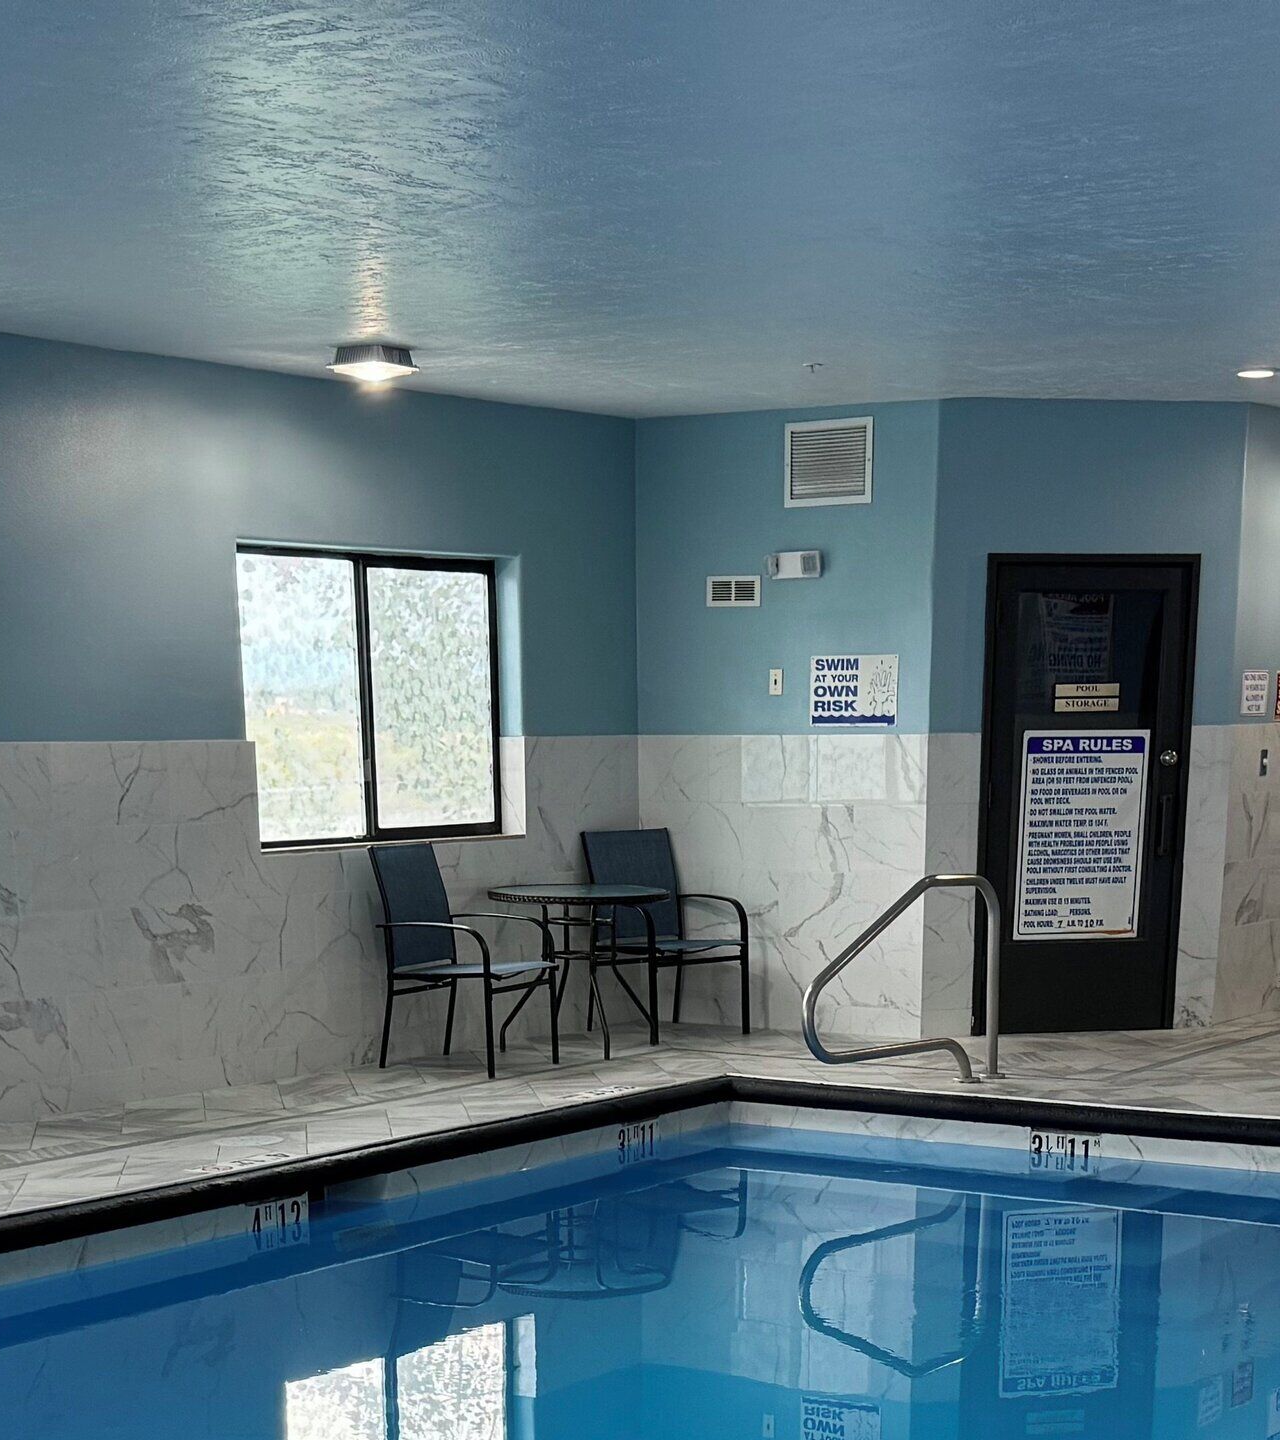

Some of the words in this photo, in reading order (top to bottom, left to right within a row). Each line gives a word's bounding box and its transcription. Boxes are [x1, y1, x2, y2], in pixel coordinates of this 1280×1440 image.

[815, 658, 859, 671] SWIM
[814, 674, 827, 683] AT
[831, 674, 858, 682] YOUR
[814, 685, 858, 697] OWN
[814, 700, 857, 712] RISK
[1042, 740, 1073, 751] SPA
[1080, 739, 1132, 751] RULES
[1057, 1136, 1066, 1149] FT
